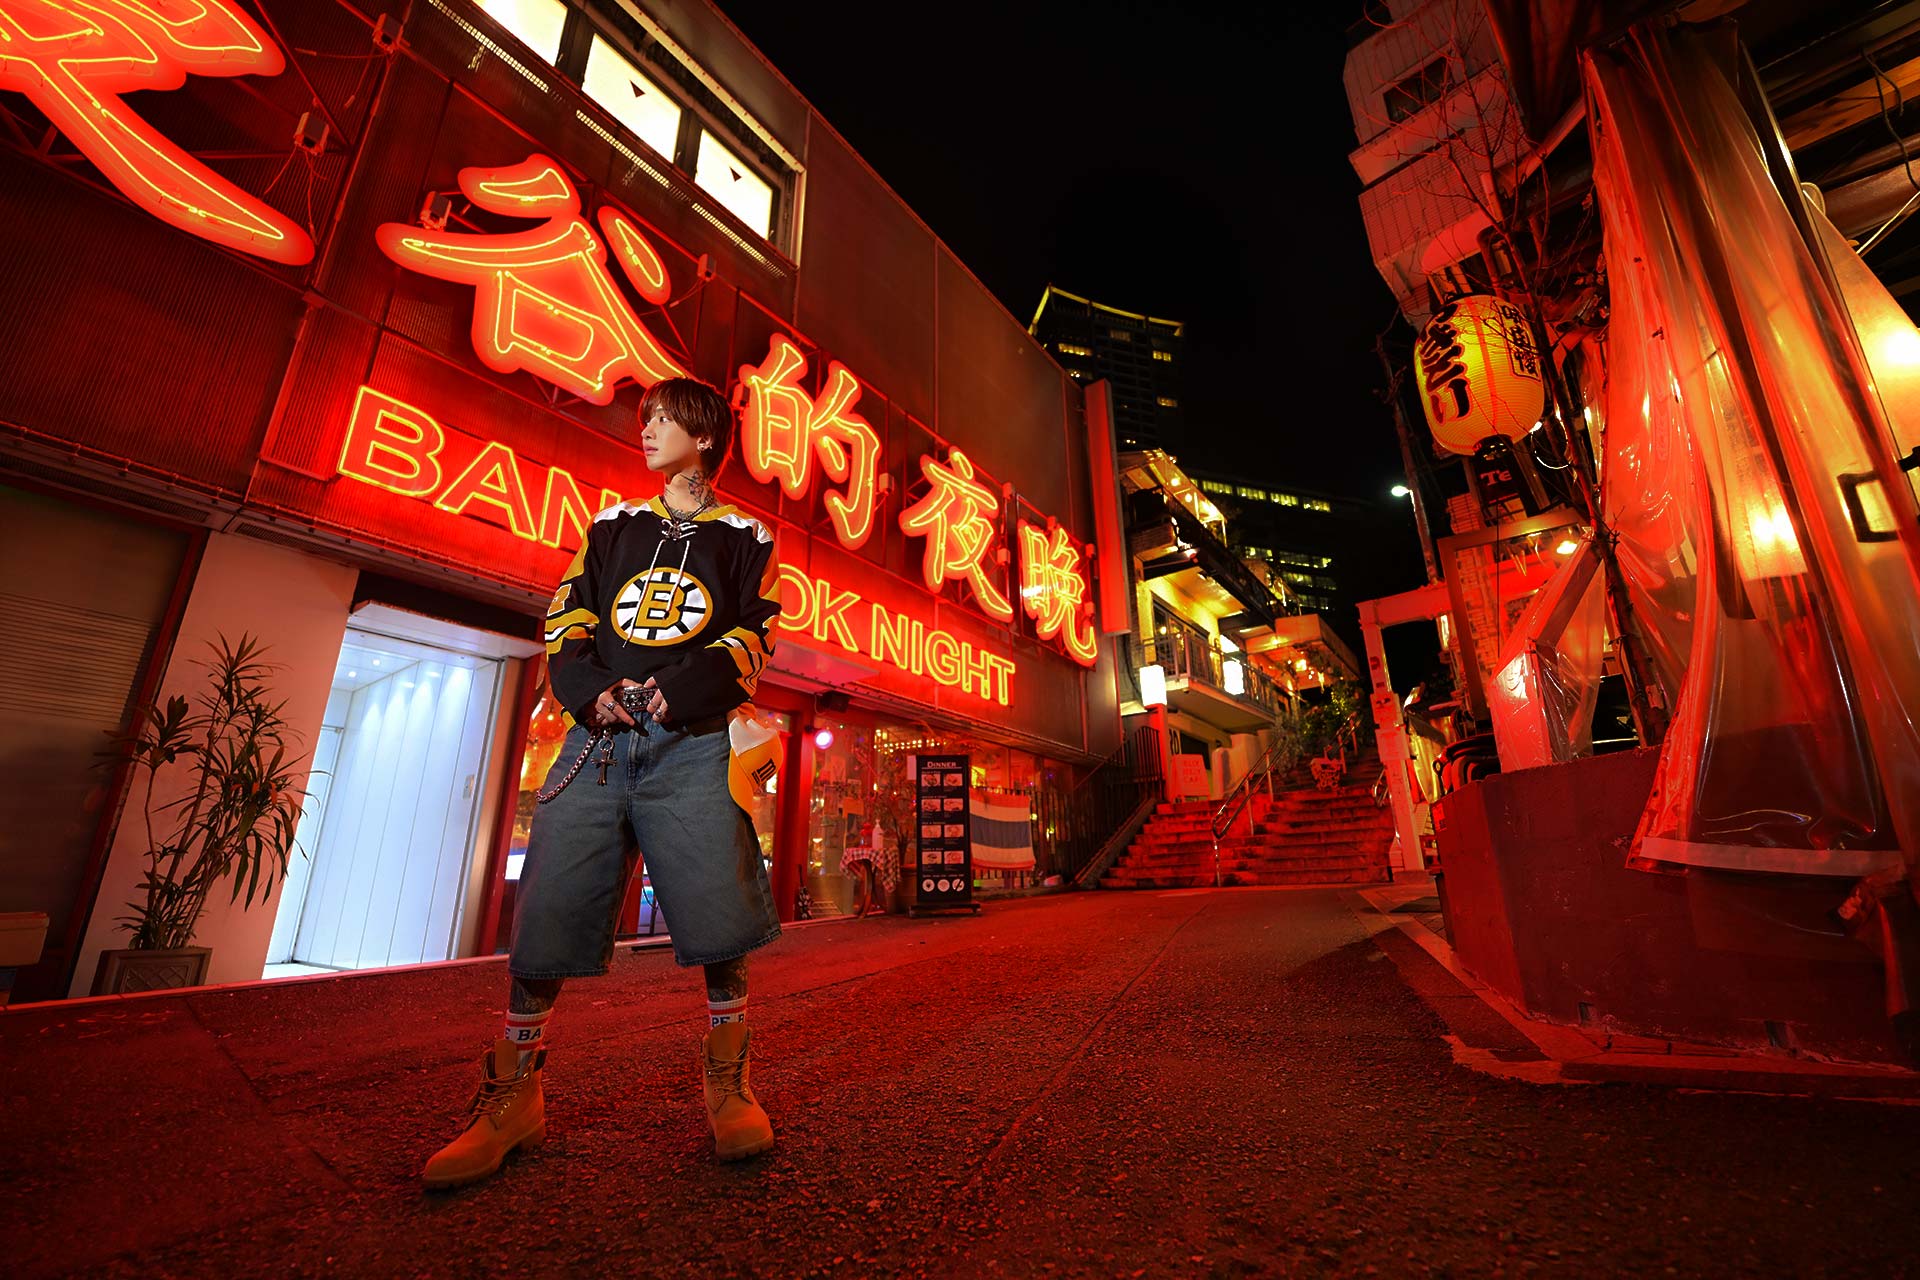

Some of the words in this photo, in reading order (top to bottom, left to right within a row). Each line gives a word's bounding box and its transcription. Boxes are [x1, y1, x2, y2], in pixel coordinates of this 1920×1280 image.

[337, 385, 861, 652] BANOK
[871, 603, 1016, 706] NIGHT
[635, 581, 686, 629] B
